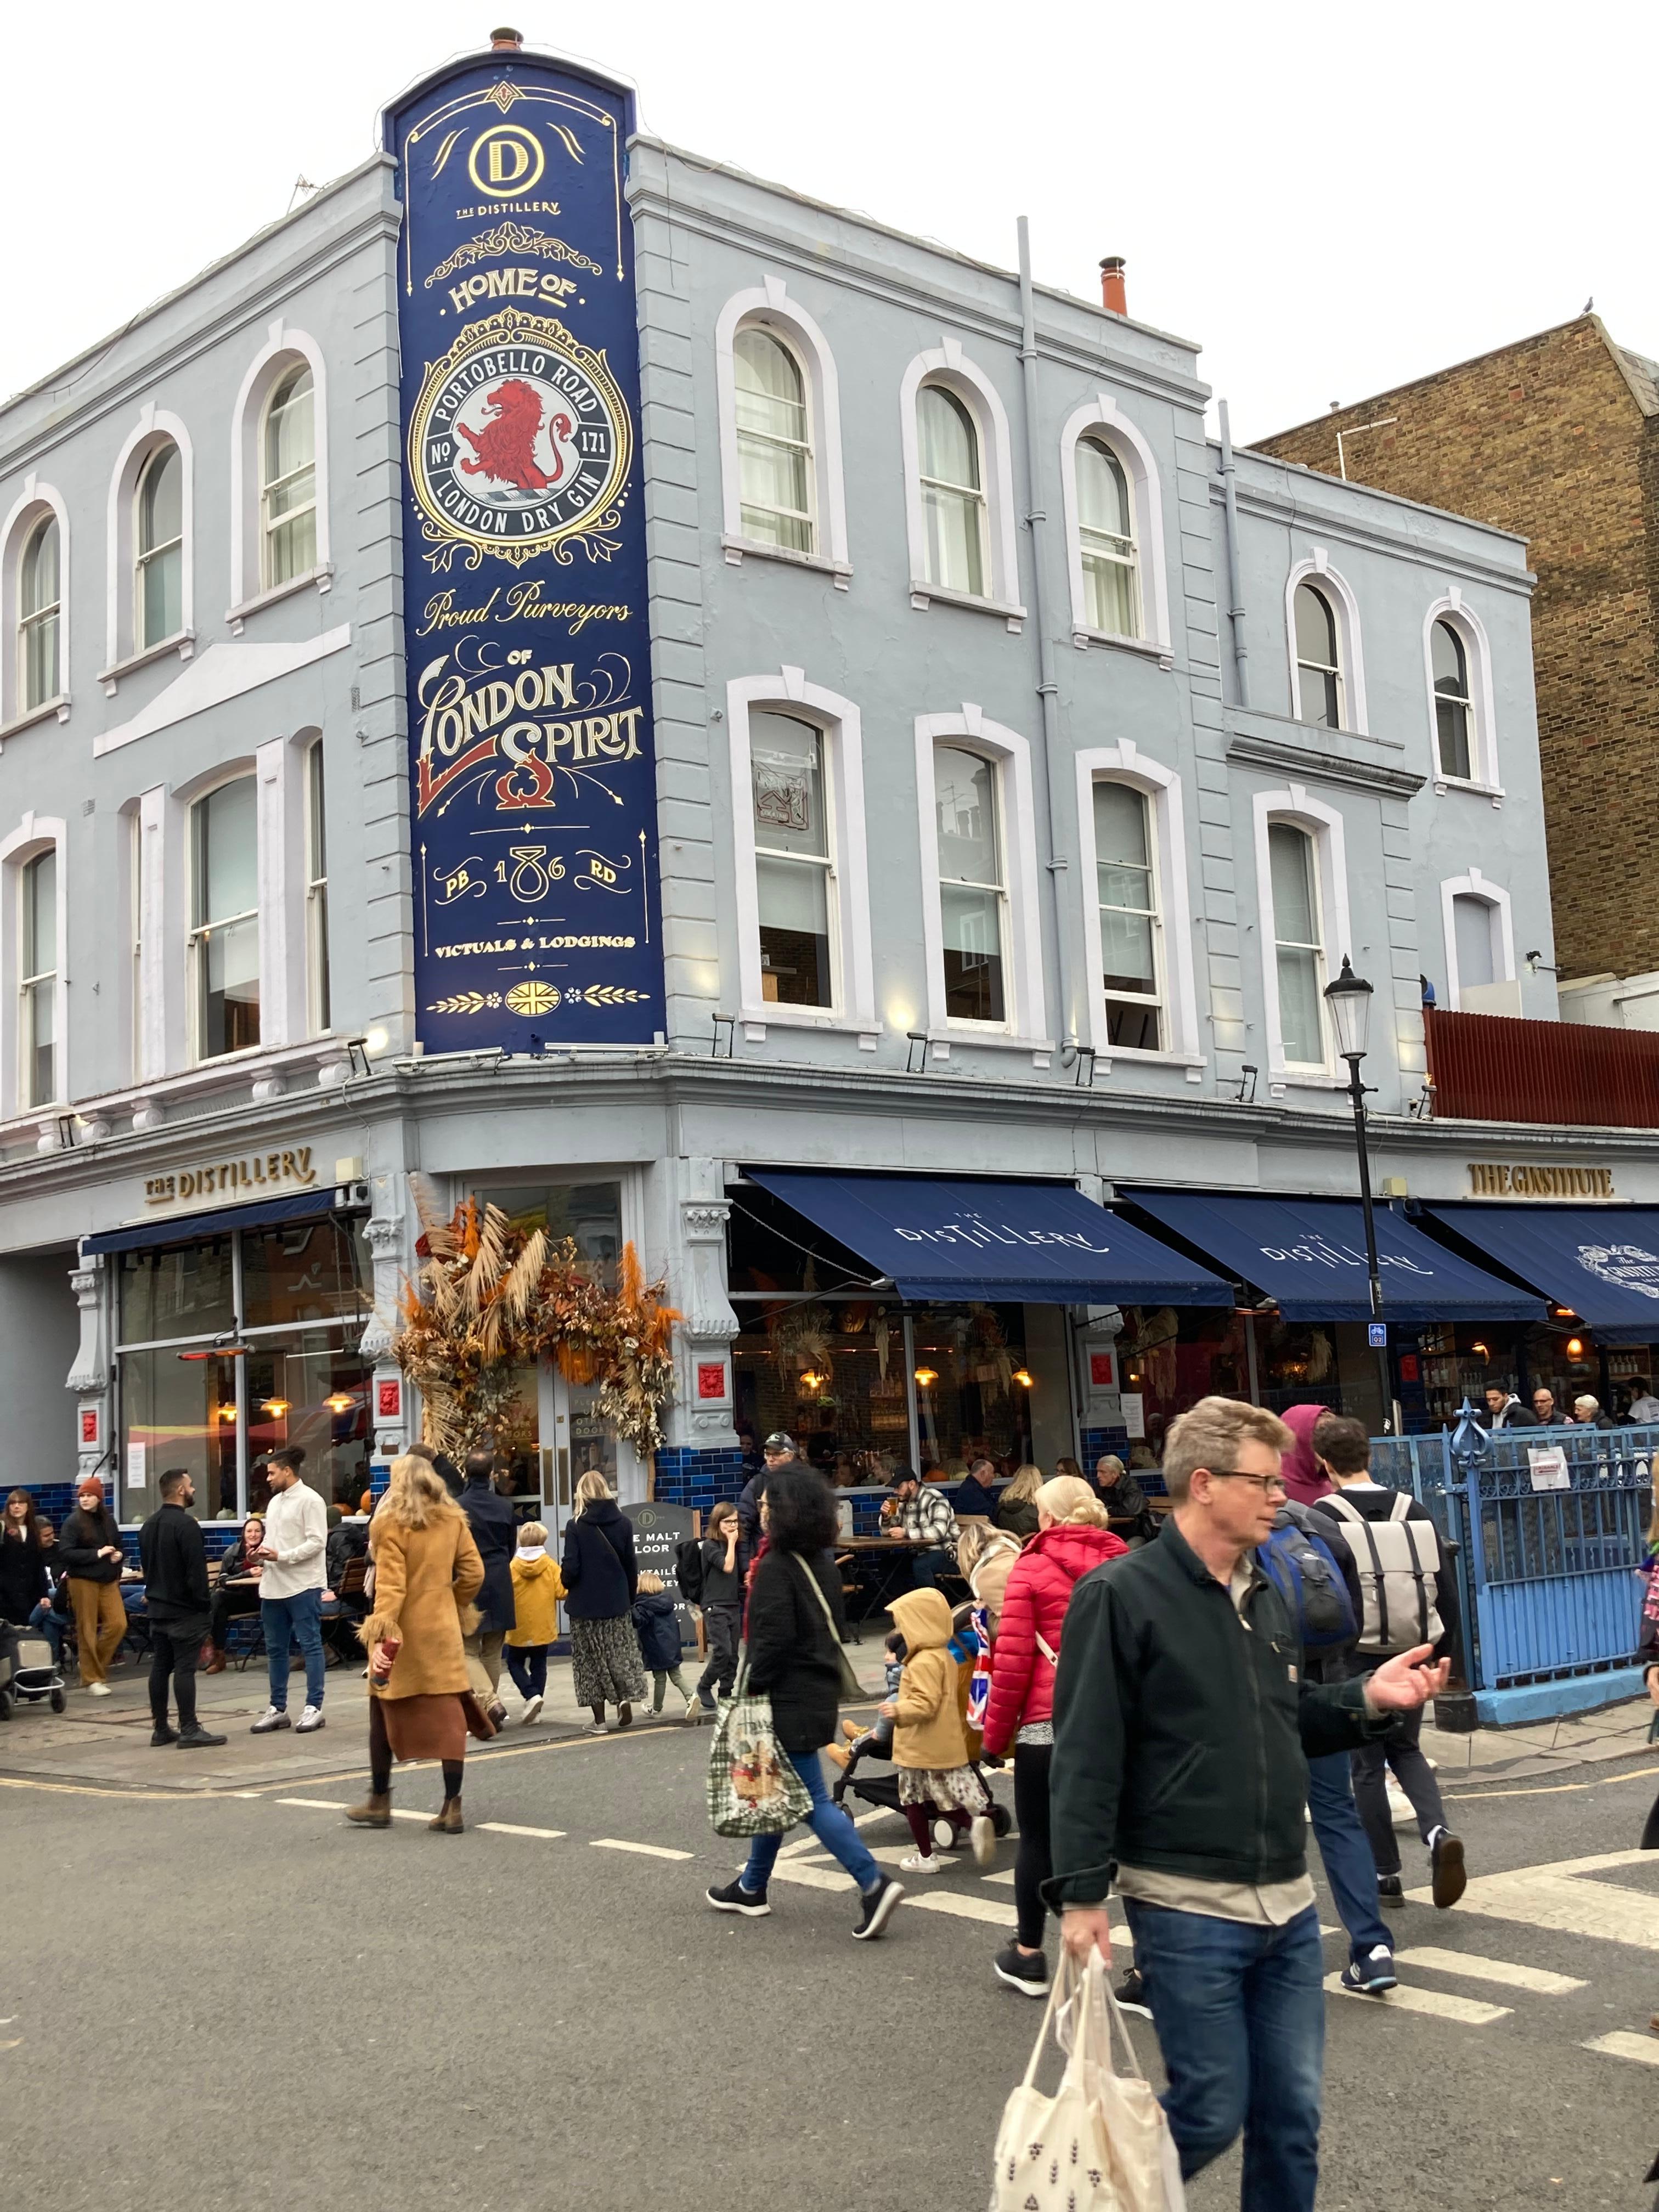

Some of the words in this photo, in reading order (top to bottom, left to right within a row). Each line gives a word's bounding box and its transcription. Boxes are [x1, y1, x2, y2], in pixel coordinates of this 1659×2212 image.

[489, 140, 528, 182] D
[456, 207, 474, 216] THE
[478, 201, 561, 216] DISTILLERY
[449, 268, 538, 314] HOME
[540, 274, 577, 297] OF
[435, 352, 545, 421] PORTOBELLO
[551, 365, 597, 413] ROAD
[582, 432, 606, 453] 171
[436, 479, 508, 533] LONDON
[521, 507, 563, 533] DRY
[568, 472, 601, 507] GIN
[416, 587, 501, 636] Proud
[495, 580, 633, 636] Purveyors
[507, 649, 533, 665] OF
[416, 654, 579, 820] LONDON
[495, 706, 644, 810] SPIRIT
[446, 870, 469, 898] PB
[591, 859, 617, 884] RD
[435, 939, 517, 958] VICTUALS
[521, 938, 535, 950] &
[539, 936, 636, 949] LODGINGS
[144, 1176, 174, 1195] THE
[179, 1147, 316, 1198] DISTILLERY
[1468, 1164, 1511, 1195] THE
[894, 1220, 1109, 1253] DISTILLERY
[635, 1544, 669, 1554] LOOR
[646, 1532, 680, 1542] MALT
